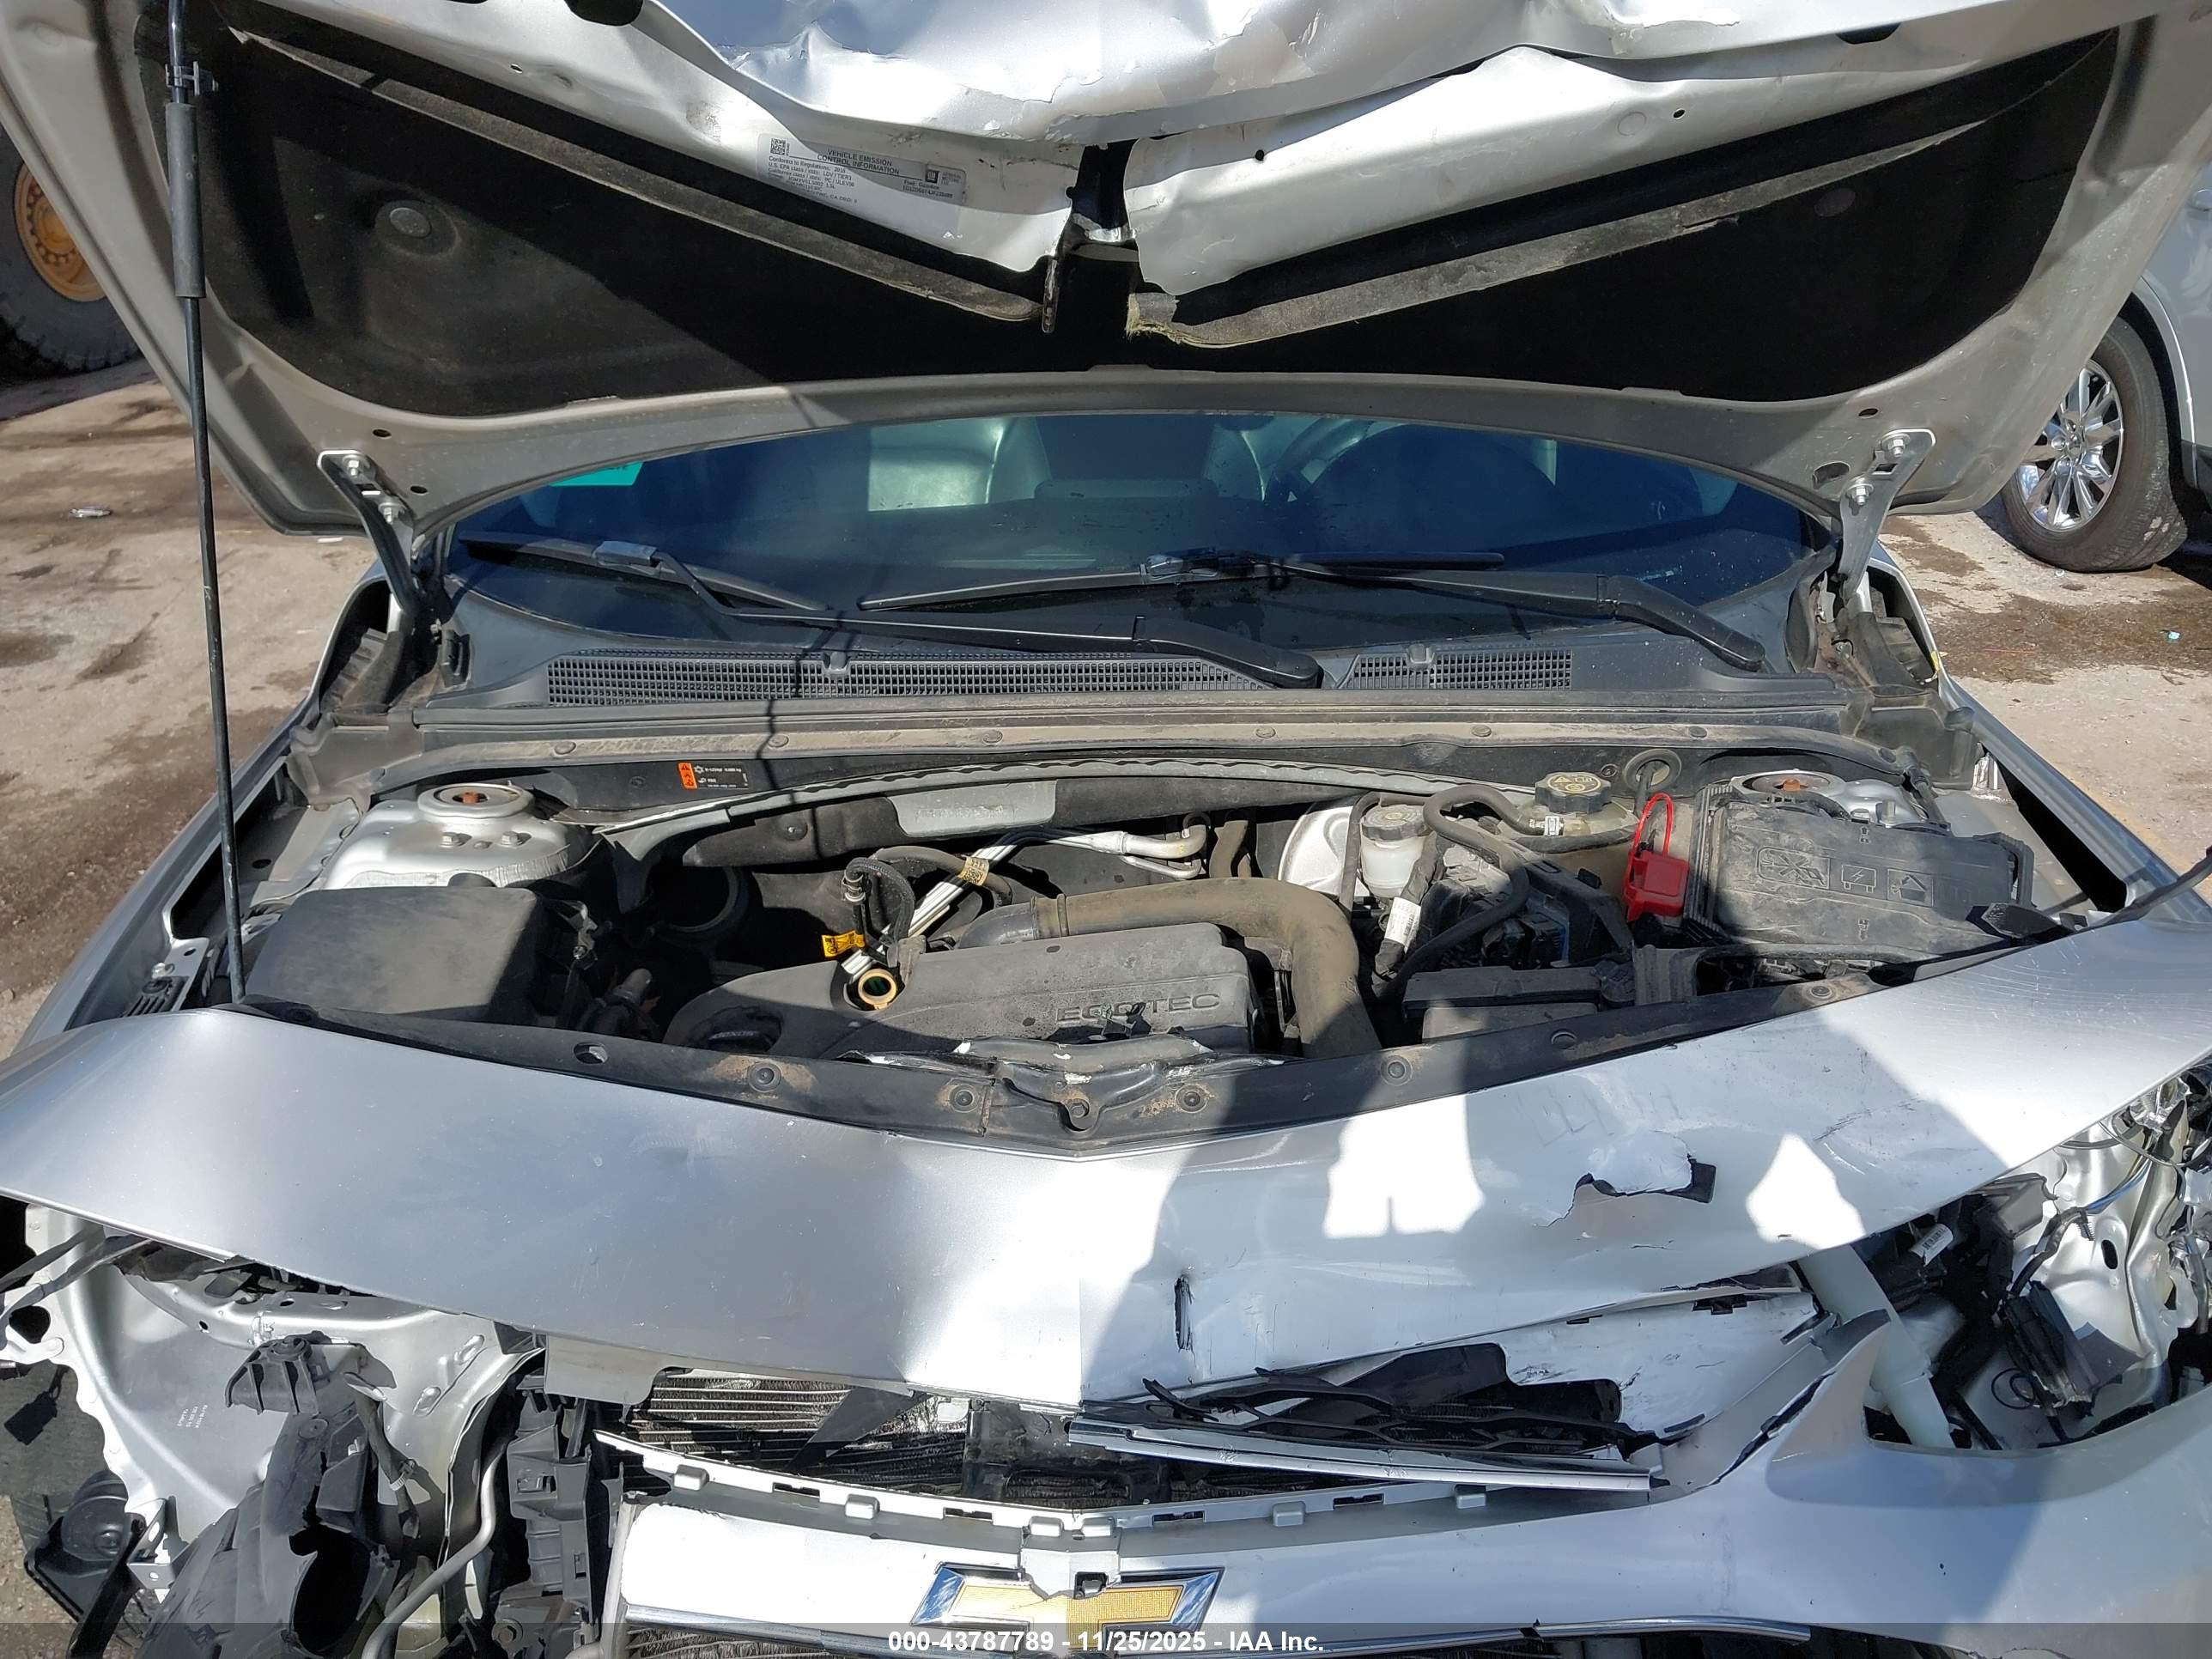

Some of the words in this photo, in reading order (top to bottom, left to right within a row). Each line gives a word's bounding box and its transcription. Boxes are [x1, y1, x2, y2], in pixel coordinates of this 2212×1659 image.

[817, 154, 850, 166] CONTROL
[852, 161, 900, 175] INFORMATION
[828, 149, 857, 160] VEHICLE
[859, 155, 892, 167] EMISSION
[1056, 994, 1221, 1023] ECOTEC
